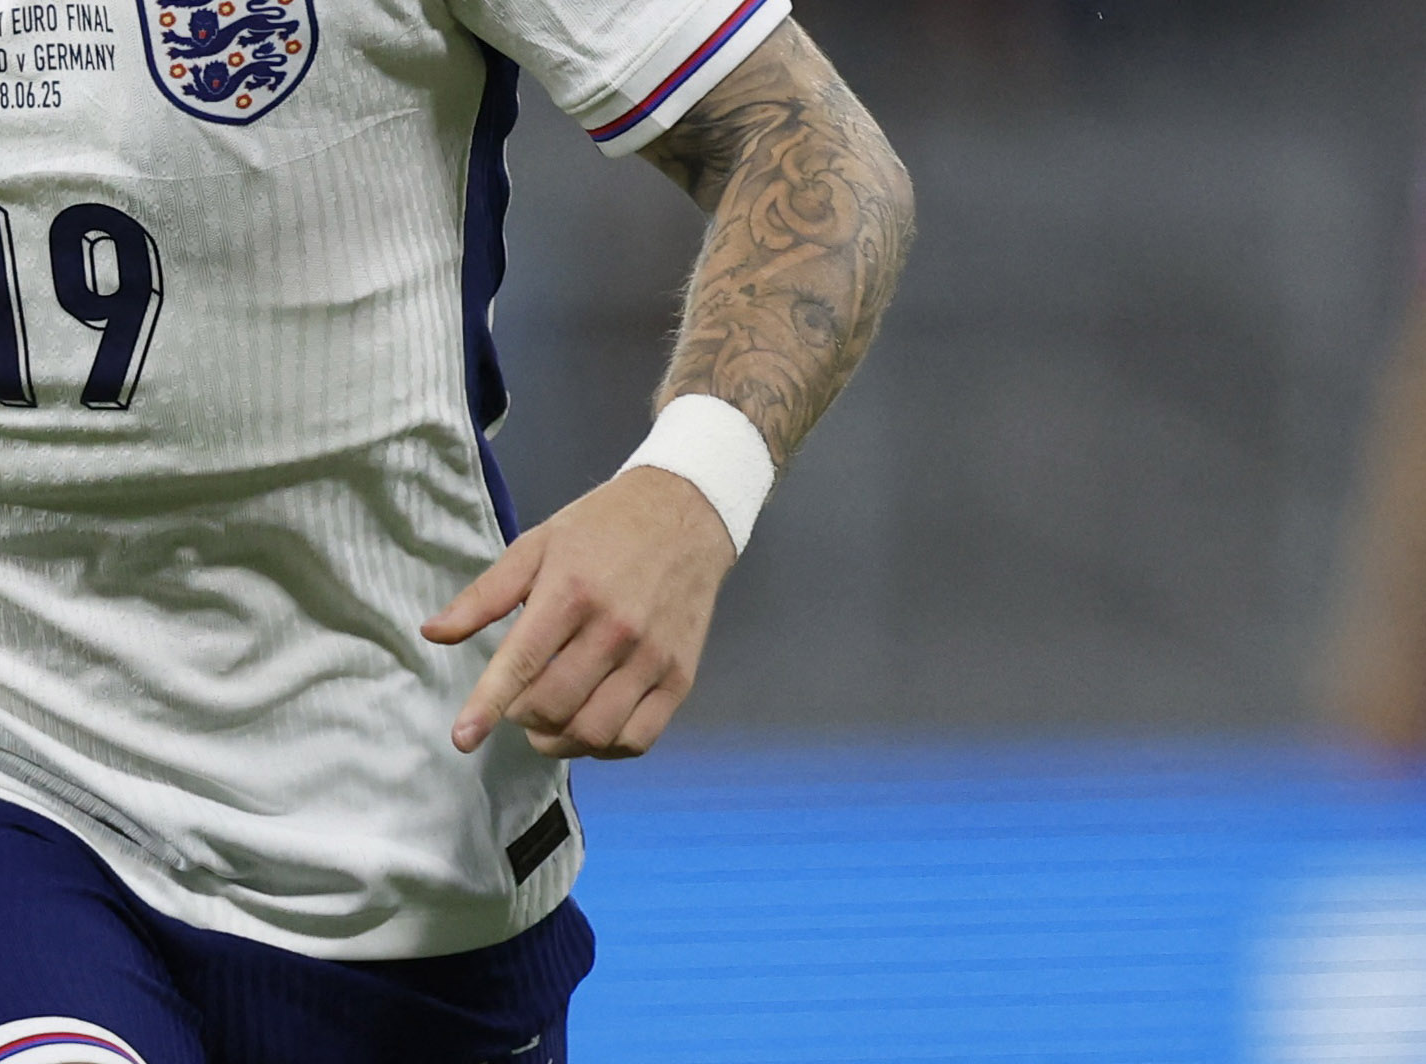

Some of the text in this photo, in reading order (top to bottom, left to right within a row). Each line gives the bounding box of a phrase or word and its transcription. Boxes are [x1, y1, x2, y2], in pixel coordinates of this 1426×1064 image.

[12, 4, 58, 35] EURO
[66, 4, 114, 33] FINAL
[16, 53, 25, 73] v
[33, 43, 115, 72] GERMANY
